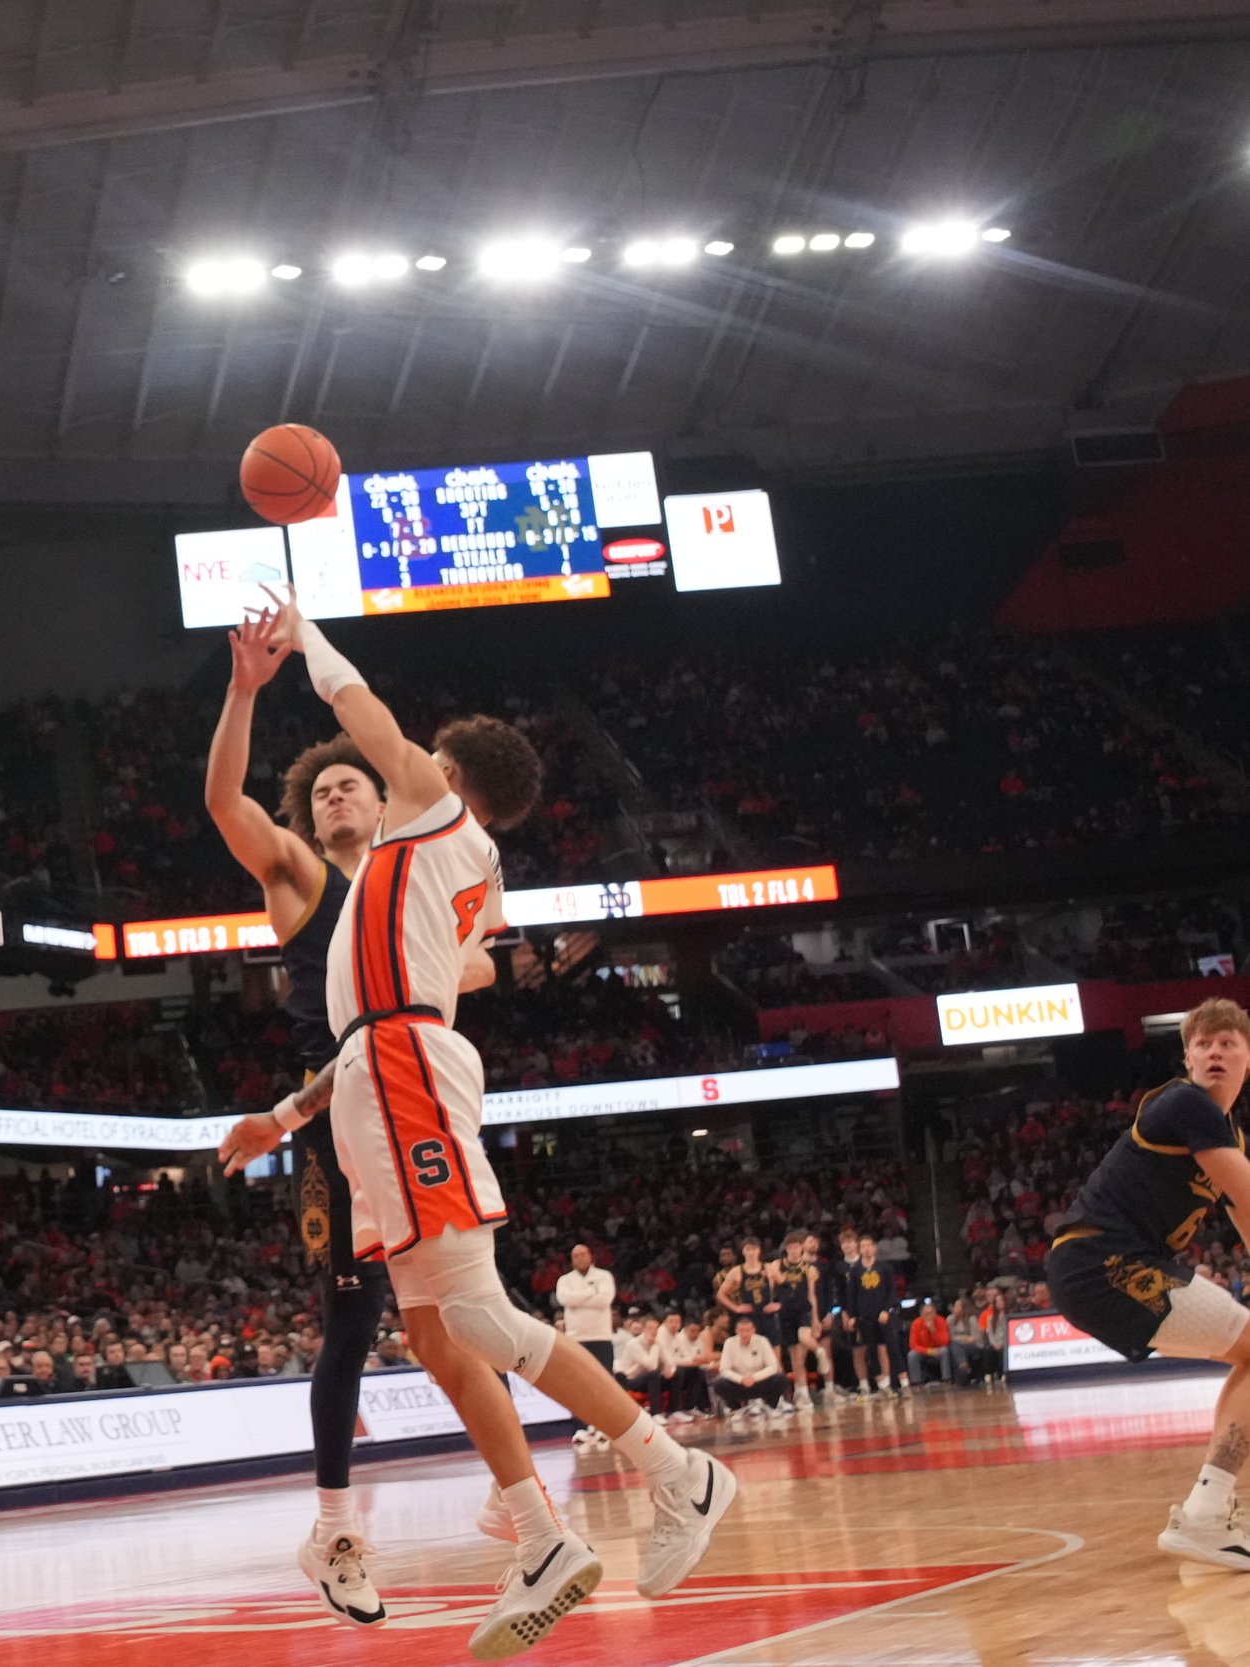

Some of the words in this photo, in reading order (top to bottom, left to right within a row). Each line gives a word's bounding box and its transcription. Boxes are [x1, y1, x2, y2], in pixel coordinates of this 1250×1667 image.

[183, 559, 232, 584] NYE
[801, 876, 815, 901] 4
[52, 1119, 98, 1141] HOTEL
[411, 1139, 451, 1186] S
[363, 1384, 436, 1413] PORTER
[40, 1416, 93, 1447] LAW
[98, 1407, 182, 1441] GROUP
